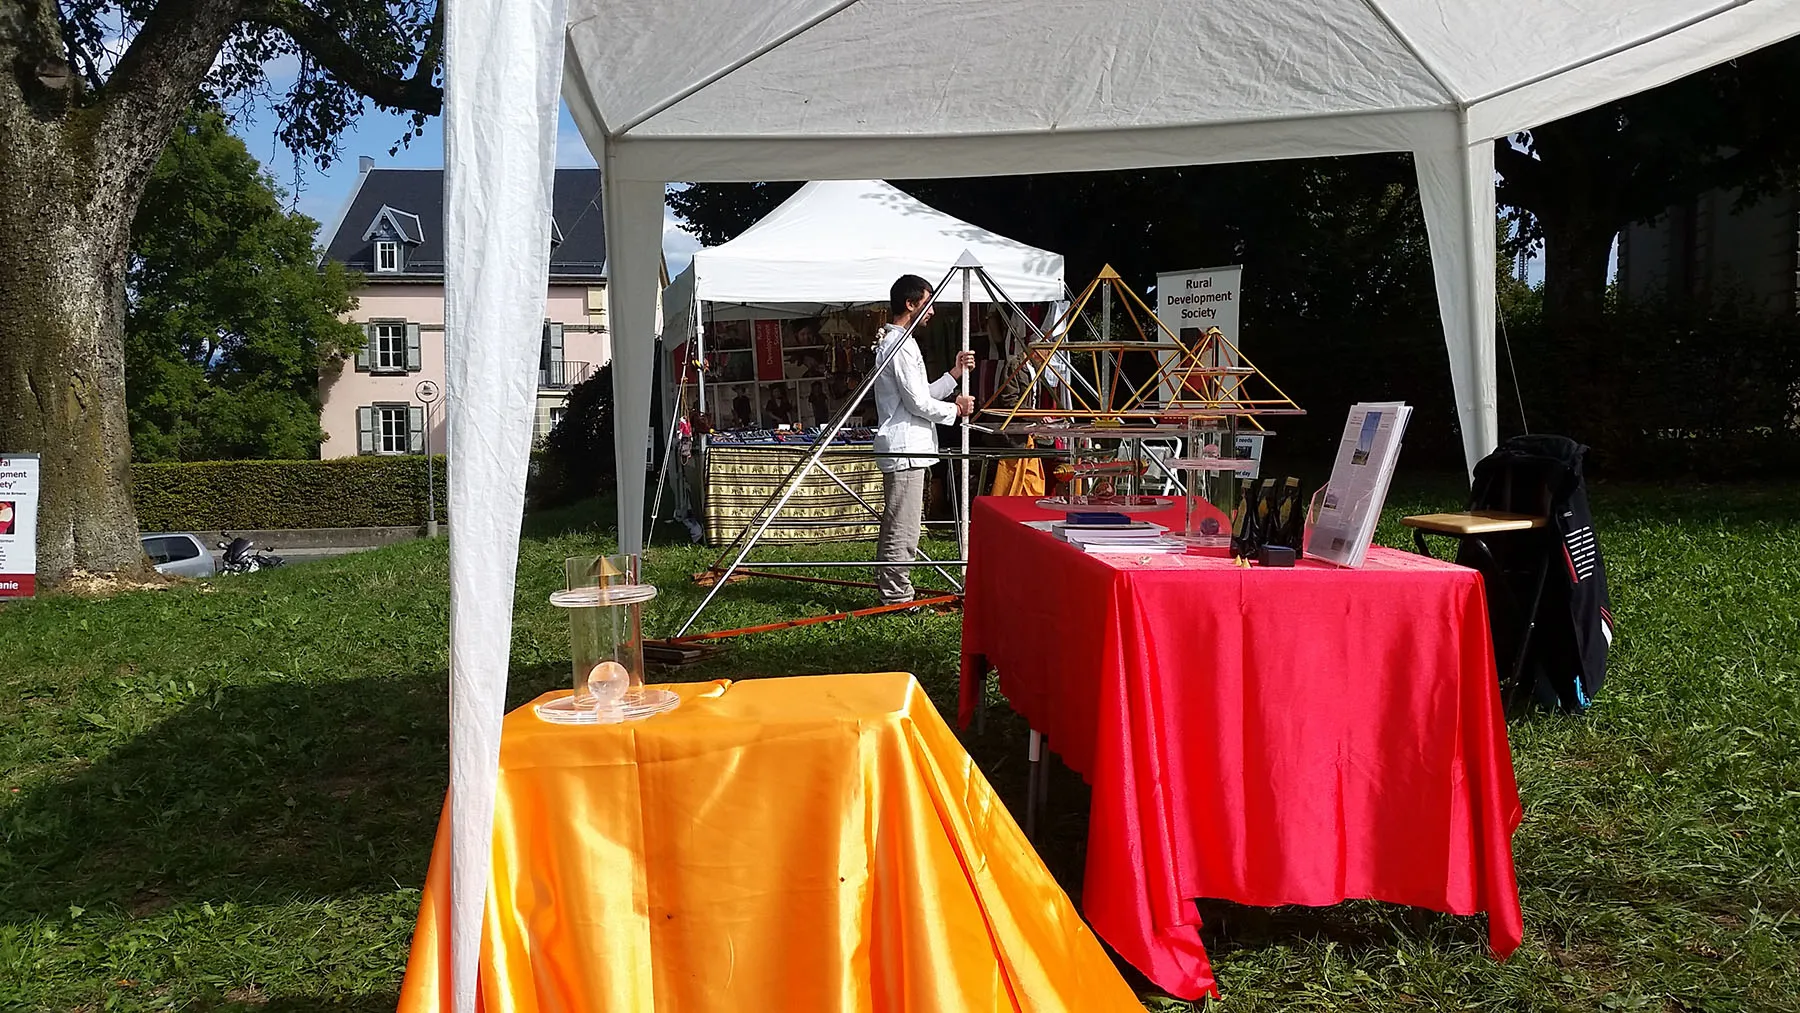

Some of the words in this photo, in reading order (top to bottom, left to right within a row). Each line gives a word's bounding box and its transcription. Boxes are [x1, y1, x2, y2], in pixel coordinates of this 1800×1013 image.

[1186, 277, 1212, 289] Rural
[1167, 290, 1233, 306] Development
[1181, 307, 1217, 320] Society
[765, 324, 773, 365] Development
